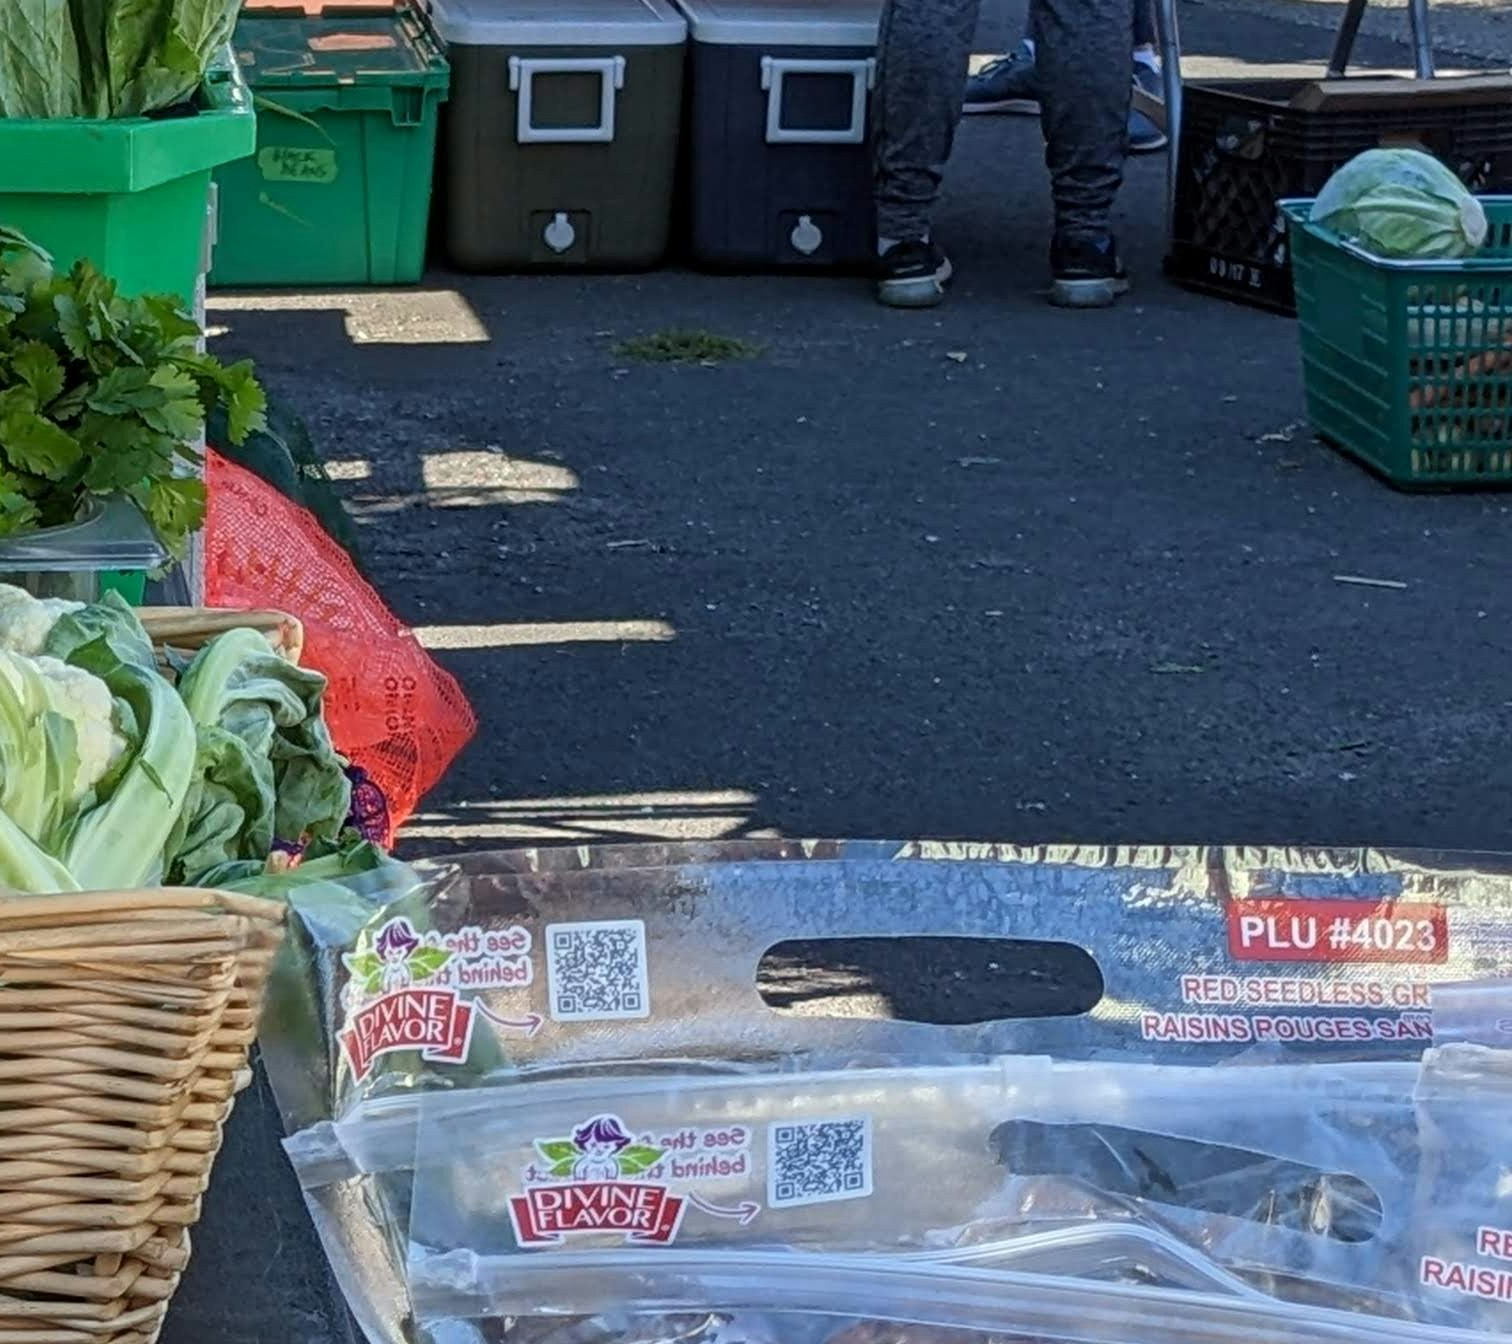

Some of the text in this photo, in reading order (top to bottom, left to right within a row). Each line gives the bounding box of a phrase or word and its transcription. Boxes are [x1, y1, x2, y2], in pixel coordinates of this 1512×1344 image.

[1240, 916, 1437, 951] PLU #4023
[1184, 977, 1237, 1002] RED
[1247, 978, 1385, 1005] SEEDLESS
[359, 994, 450, 1040] DIVINE
[1143, 1016, 1249, 1041] RAISINS
[1255, 1019, 1371, 1041] ROUGES
[363, 1018, 444, 1058] FLAVOR
[534, 1186, 660, 1209] DIVINE
[540, 1208, 650, 1228] FLAVOR
